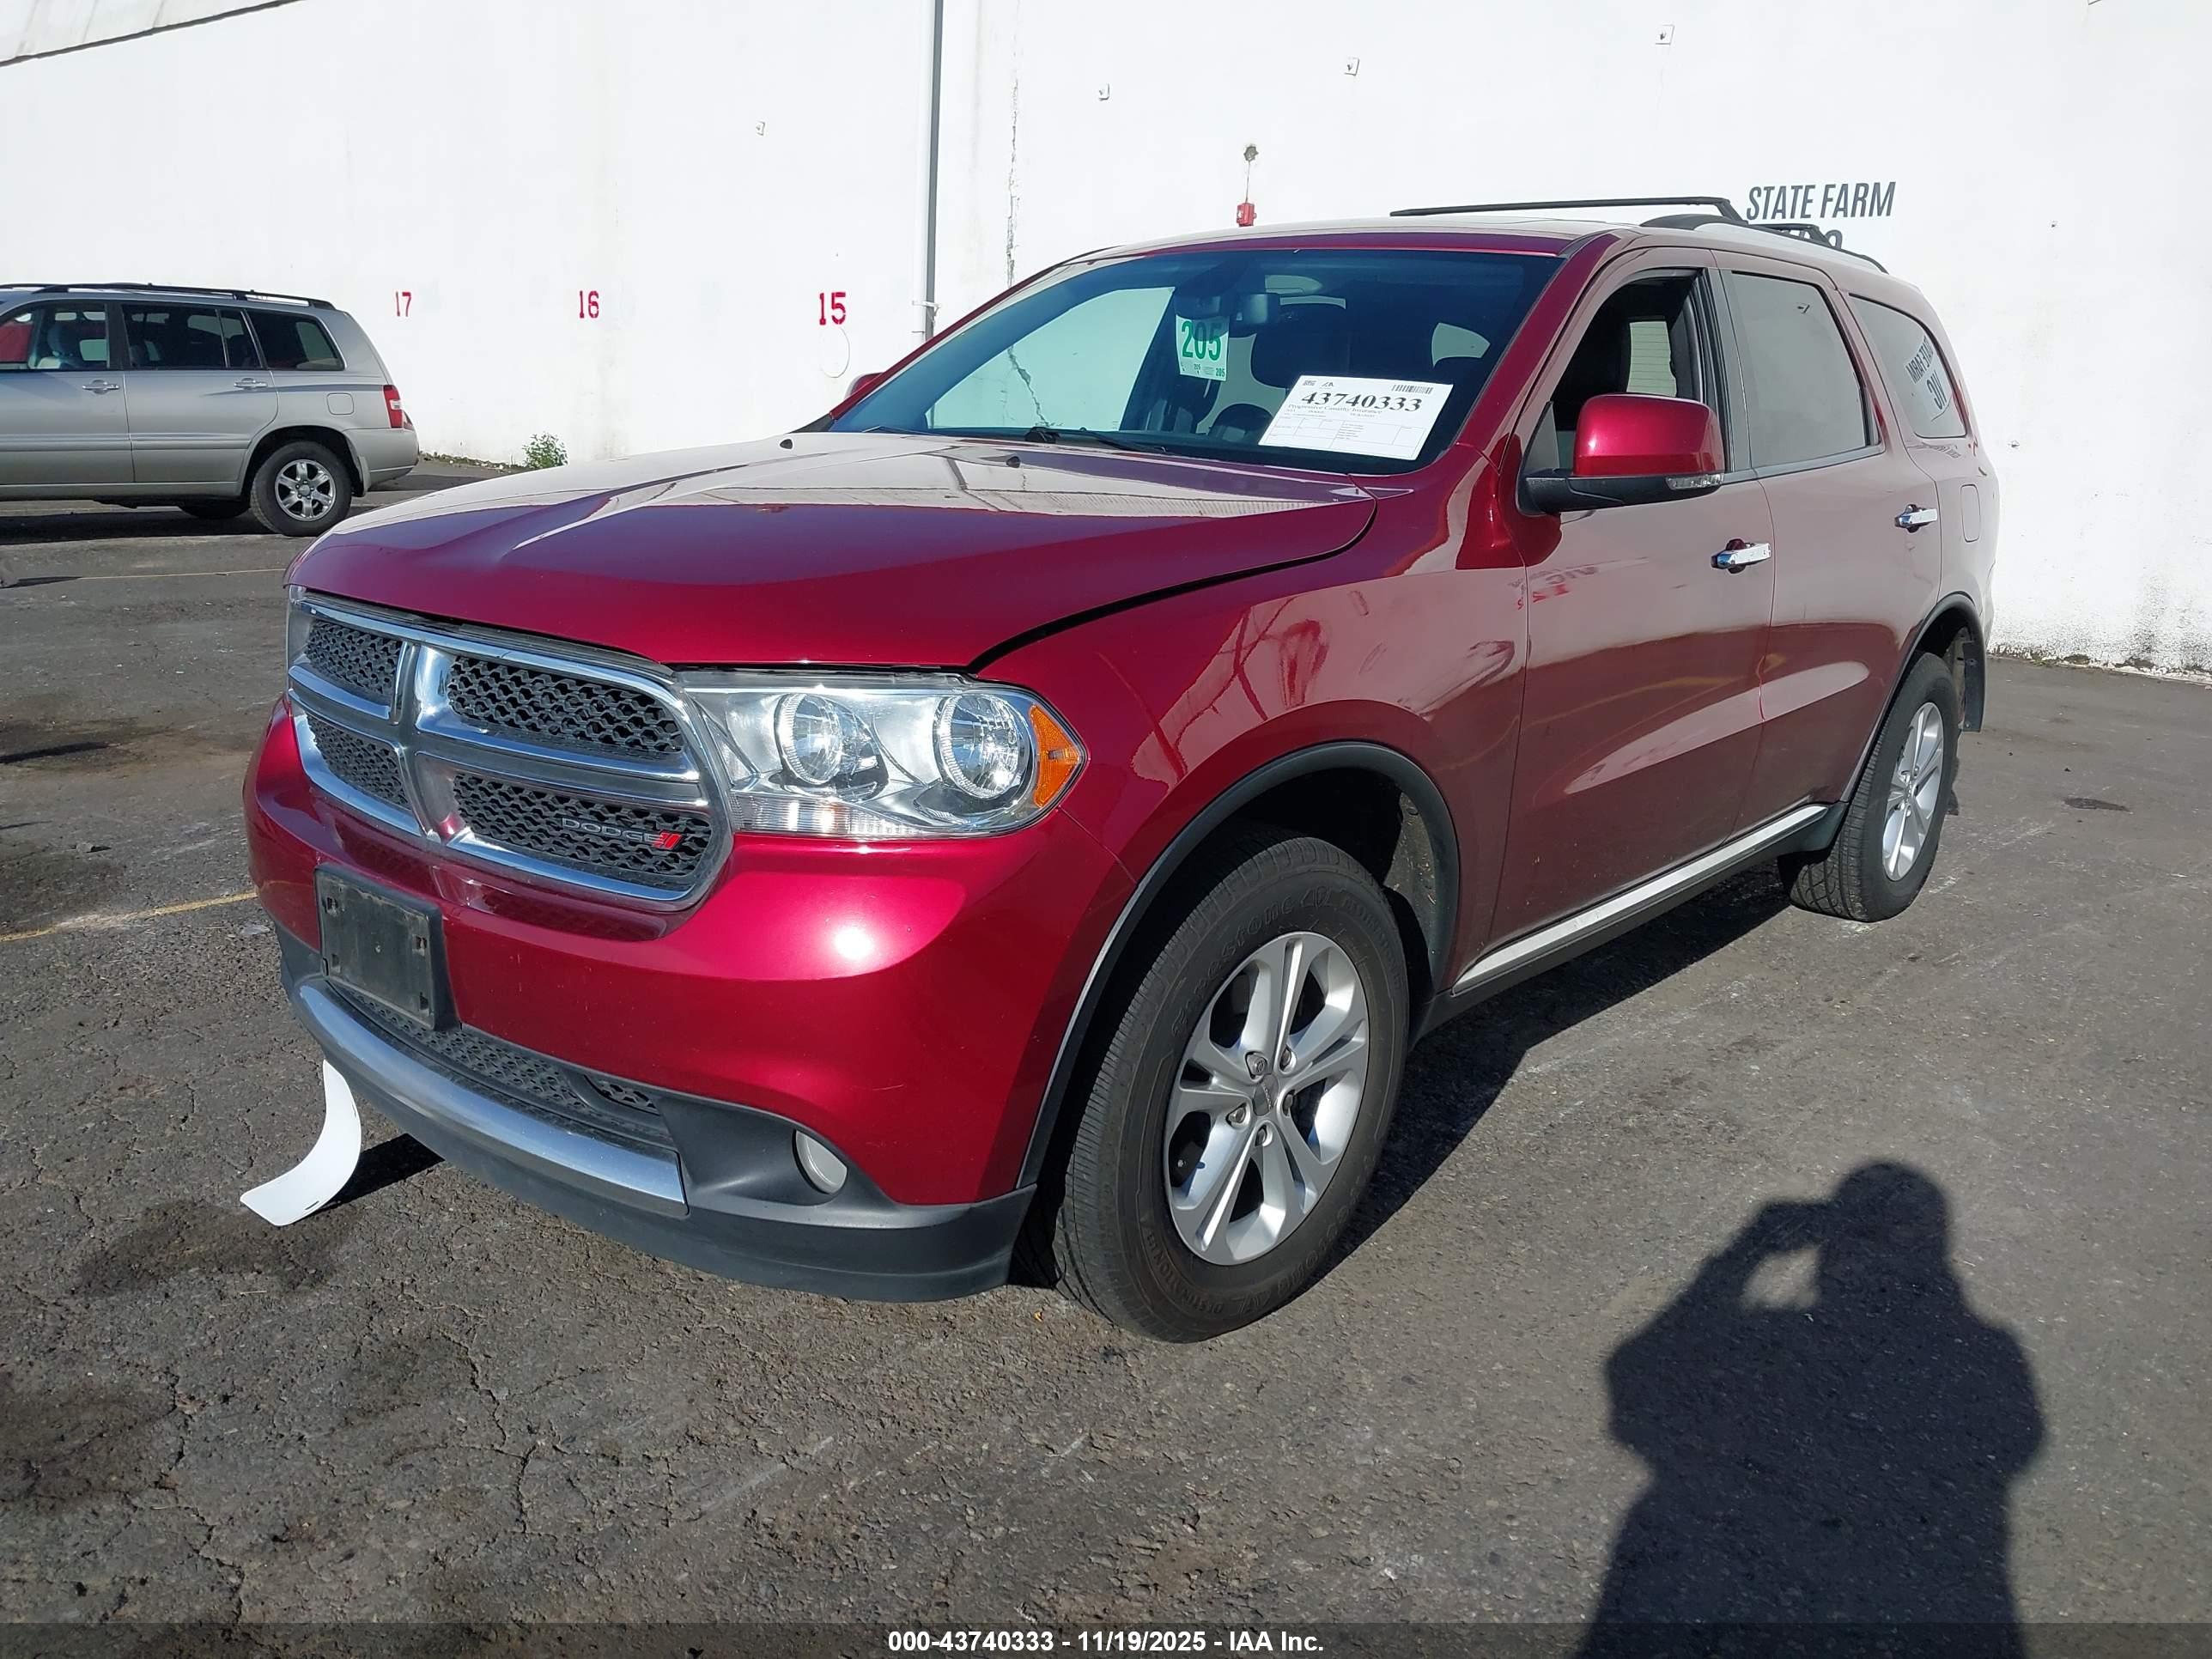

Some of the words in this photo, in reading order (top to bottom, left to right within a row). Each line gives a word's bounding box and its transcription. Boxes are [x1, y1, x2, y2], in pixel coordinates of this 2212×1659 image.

[1747, 185, 1815, 220] STATE
[1820, 182, 1896, 218] FARM
[395, 291, 411, 317] 17
[579, 290, 599, 319] 16
[819, 292, 846, 325] 15
[1182, 320, 1221, 361] 205
[1302, 392, 1422, 412] 43740333
[562, 817, 664, 846] DODGE
